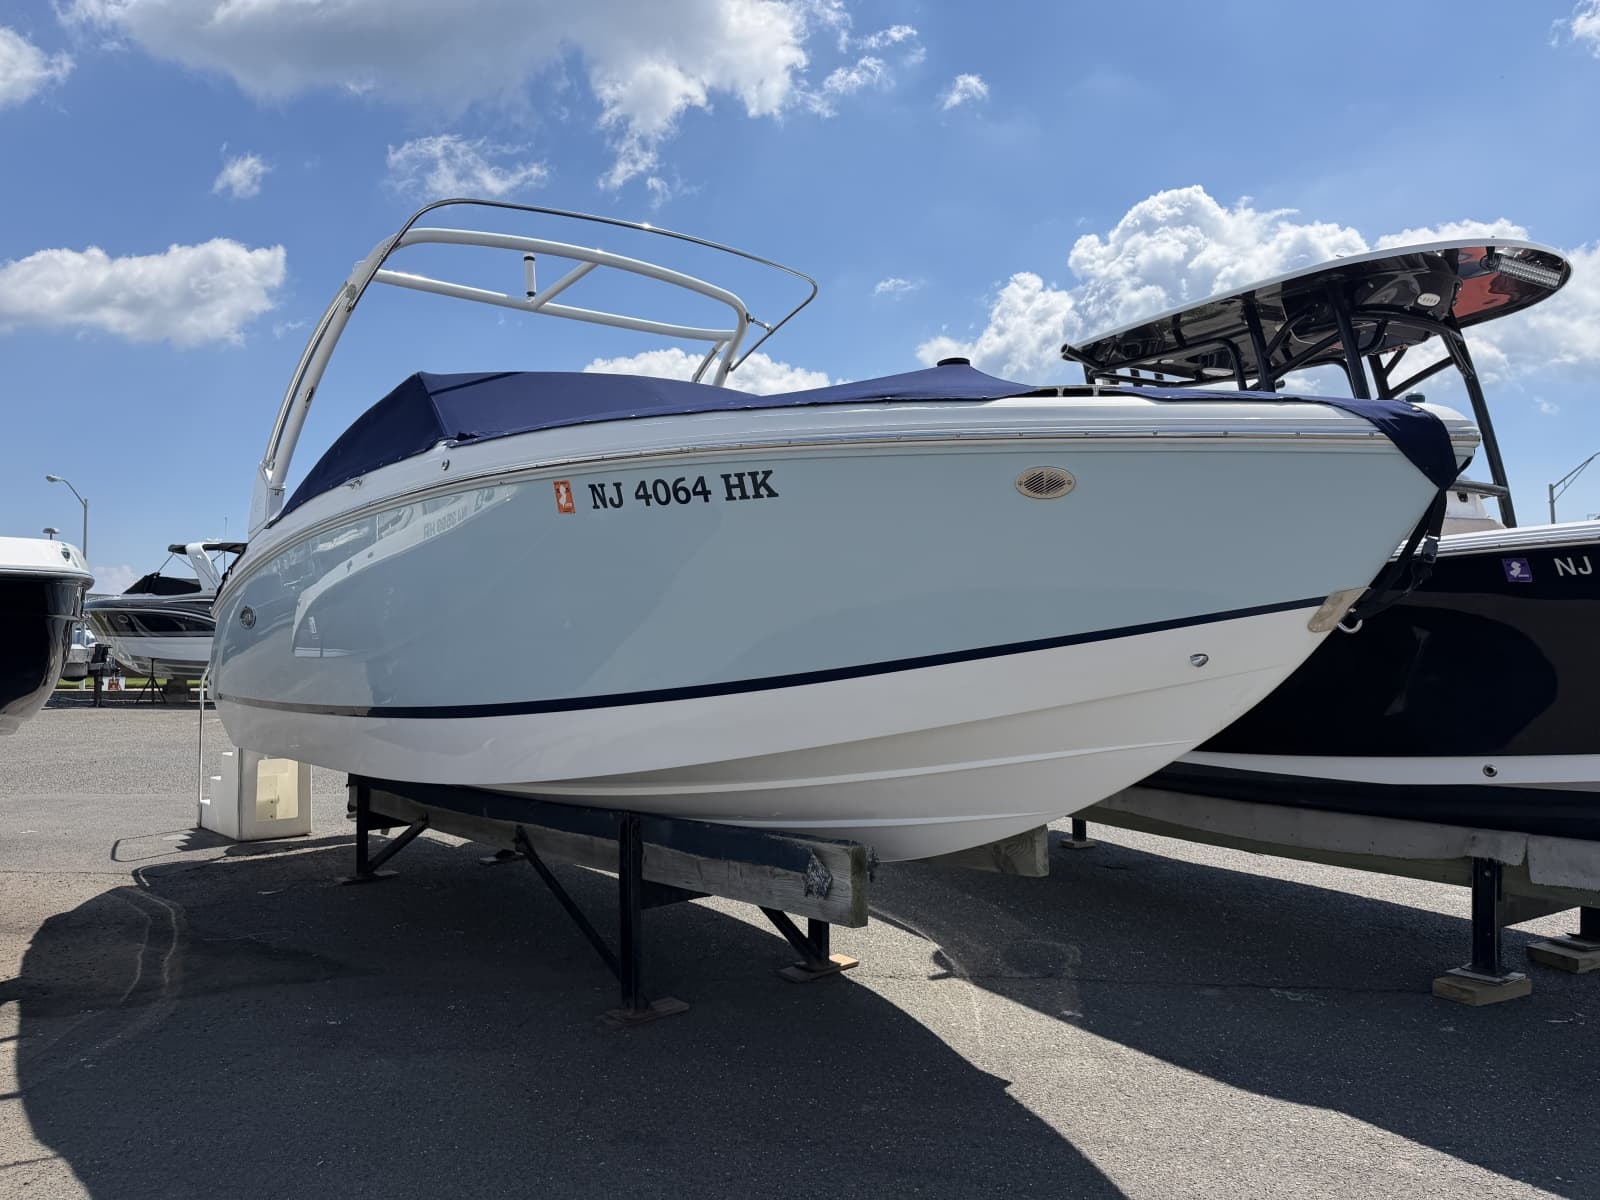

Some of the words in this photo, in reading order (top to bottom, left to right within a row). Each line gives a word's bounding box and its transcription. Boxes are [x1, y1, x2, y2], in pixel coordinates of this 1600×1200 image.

[588, 482, 624, 509] NJ
[634, 475, 712, 507] 4064
[720, 469, 779, 502] HK
[1553, 555, 1593, 577] NJ
